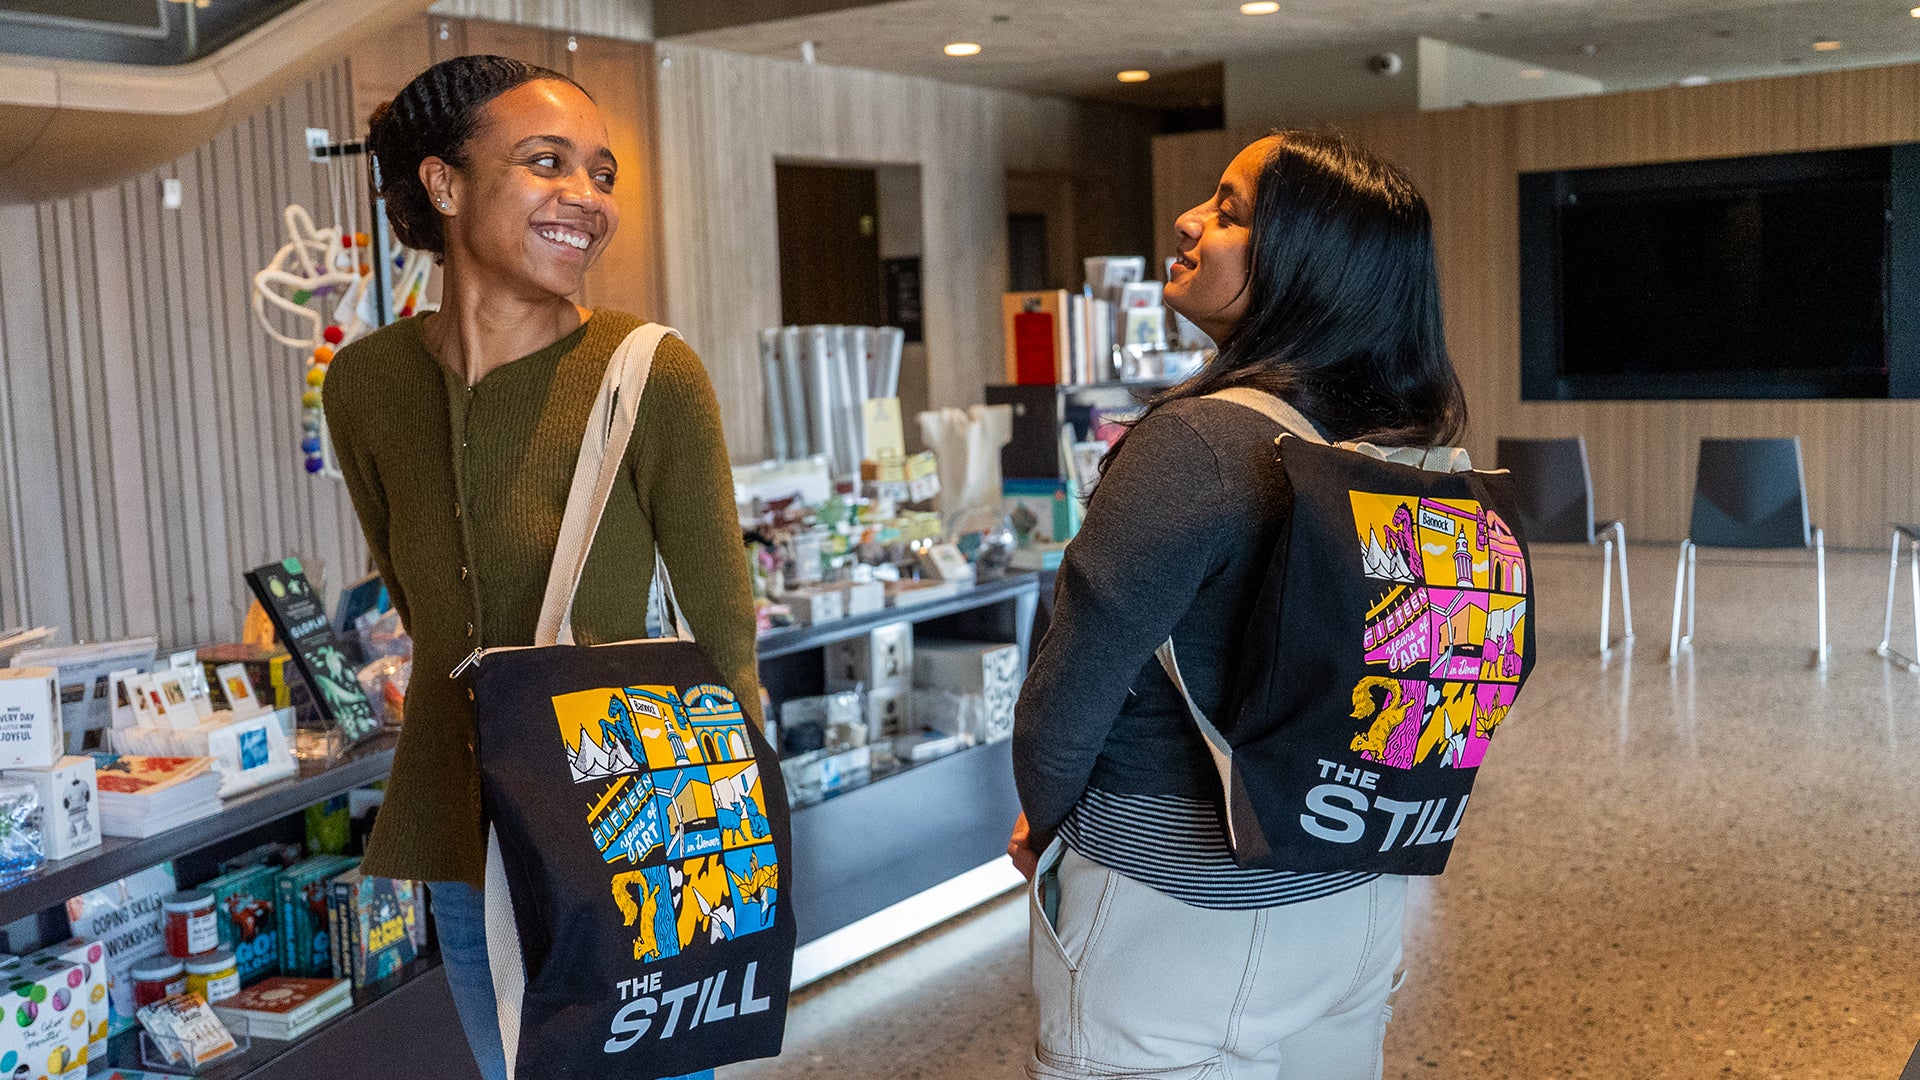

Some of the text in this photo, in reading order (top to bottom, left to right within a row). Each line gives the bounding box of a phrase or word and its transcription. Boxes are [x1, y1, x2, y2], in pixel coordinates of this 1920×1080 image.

[1422, 513, 1449, 532] Bannock
[1364, 589, 1428, 646] FIFTEEN
[1385, 615, 1428, 670] years of
[1400, 635, 1426, 670] ART
[633, 700, 658, 716] Bannock
[699, 683, 735, 702] STATION
[0, 713, 34, 722] VERY DAY
[1, 731, 32, 741] JOYFUL
[1317, 758, 1381, 790] THE
[593, 774, 652, 846] FIFTEEN
[1300, 783, 1469, 852] STILL
[620, 801, 657, 861] years of
[635, 821, 659, 857] ART
[686, 833, 720, 853] in Denver
[92, 906, 129, 936] COPING
[105, 920, 161, 957] WORKBOOK
[616, 971, 663, 1000] THE
[603, 961, 771, 1053] STILL
